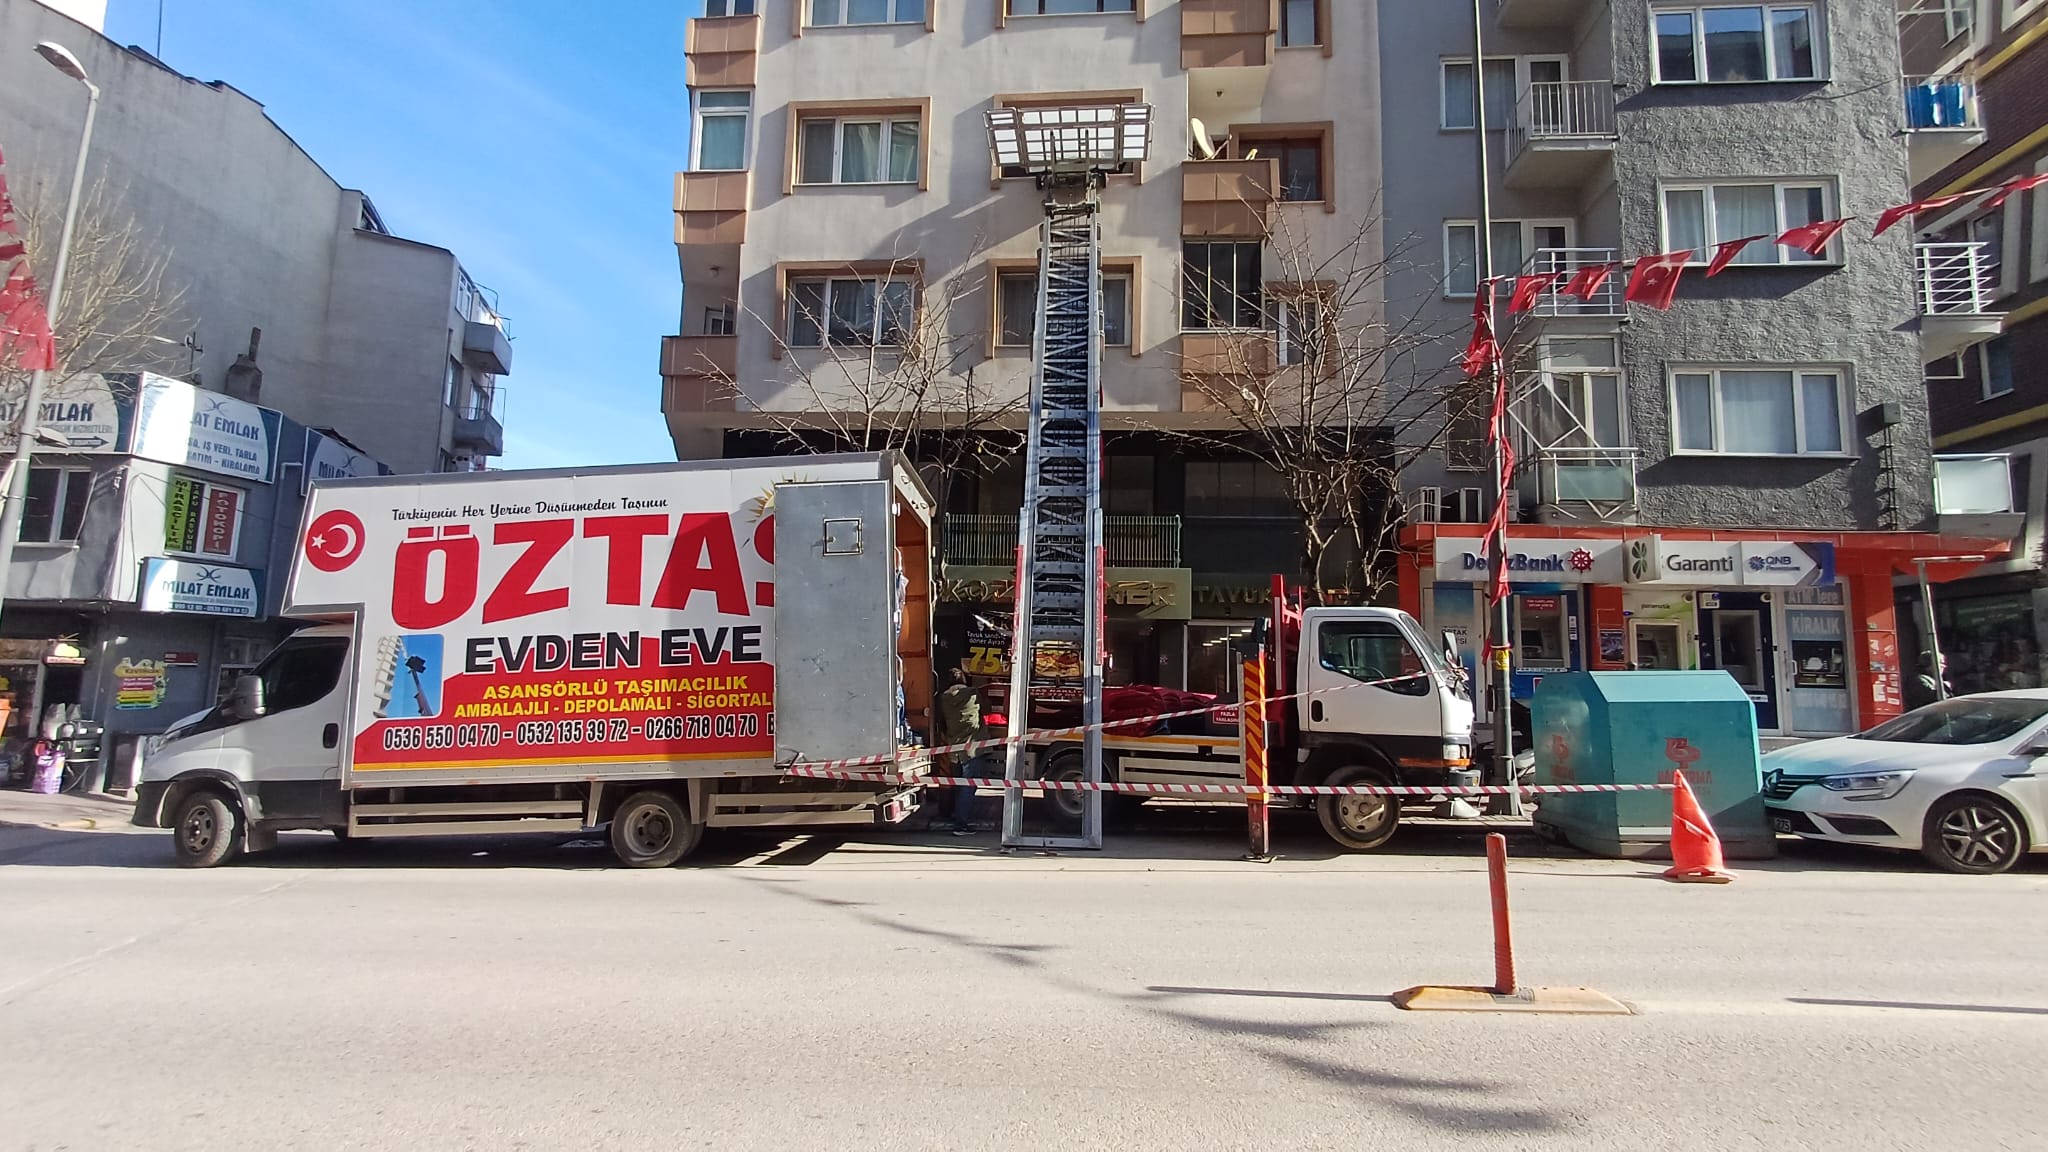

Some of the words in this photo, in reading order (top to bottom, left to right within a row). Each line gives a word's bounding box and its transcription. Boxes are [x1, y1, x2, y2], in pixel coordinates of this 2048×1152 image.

[38, 403, 94, 421] MLAK
[214, 416, 260, 440] EMLAK
[235, 448, 257, 461] TARLA
[221, 458, 260, 475] KIRALAMA
[191, 484, 200, 506] TAPU
[392, 508, 457, 521] Türkiyenin
[462, 505, 485, 518] Her
[490, 503, 531, 517] Yerine
[535, 498, 616, 516] Düşünmeden
[1463, 552, 1564, 572] DezBank
[1667, 554, 1733, 572] Garanti
[1766, 556, 1792, 565] QNB
[163, 581, 203, 596] MILAT
[206, 584, 250, 599] EMLAK
[1792, 612, 1840, 634] KİRALIK
[464, 630, 640, 673] EVDEN
[660, 625, 762, 665] EVE
[970, 646, 1002, 673] 75
[483, 679, 608, 700] ASANSÖRLÜ
[614, 675, 748, 697] TAŞIMACILIK
[454, 701, 549, 718] AMBALAJLI
[564, 696, 671, 714] DEPOLAMALI
[384, 727, 420, 750] 0536
[425, 724, 453, 747] 550
[458, 724, 477, 746] 04
[481, 723, 500, 745] 70
[517, 721, 554, 745] 0532
[557, 720, 583, 743] 135
[586, 719, 607, 742] 39
[609, 717, 629, 741] 72
[645, 716, 683, 740] 0266
[686, 714, 710, 739] 718
[715, 714, 735, 737] 04
[739, 713, 758, 737] 70
